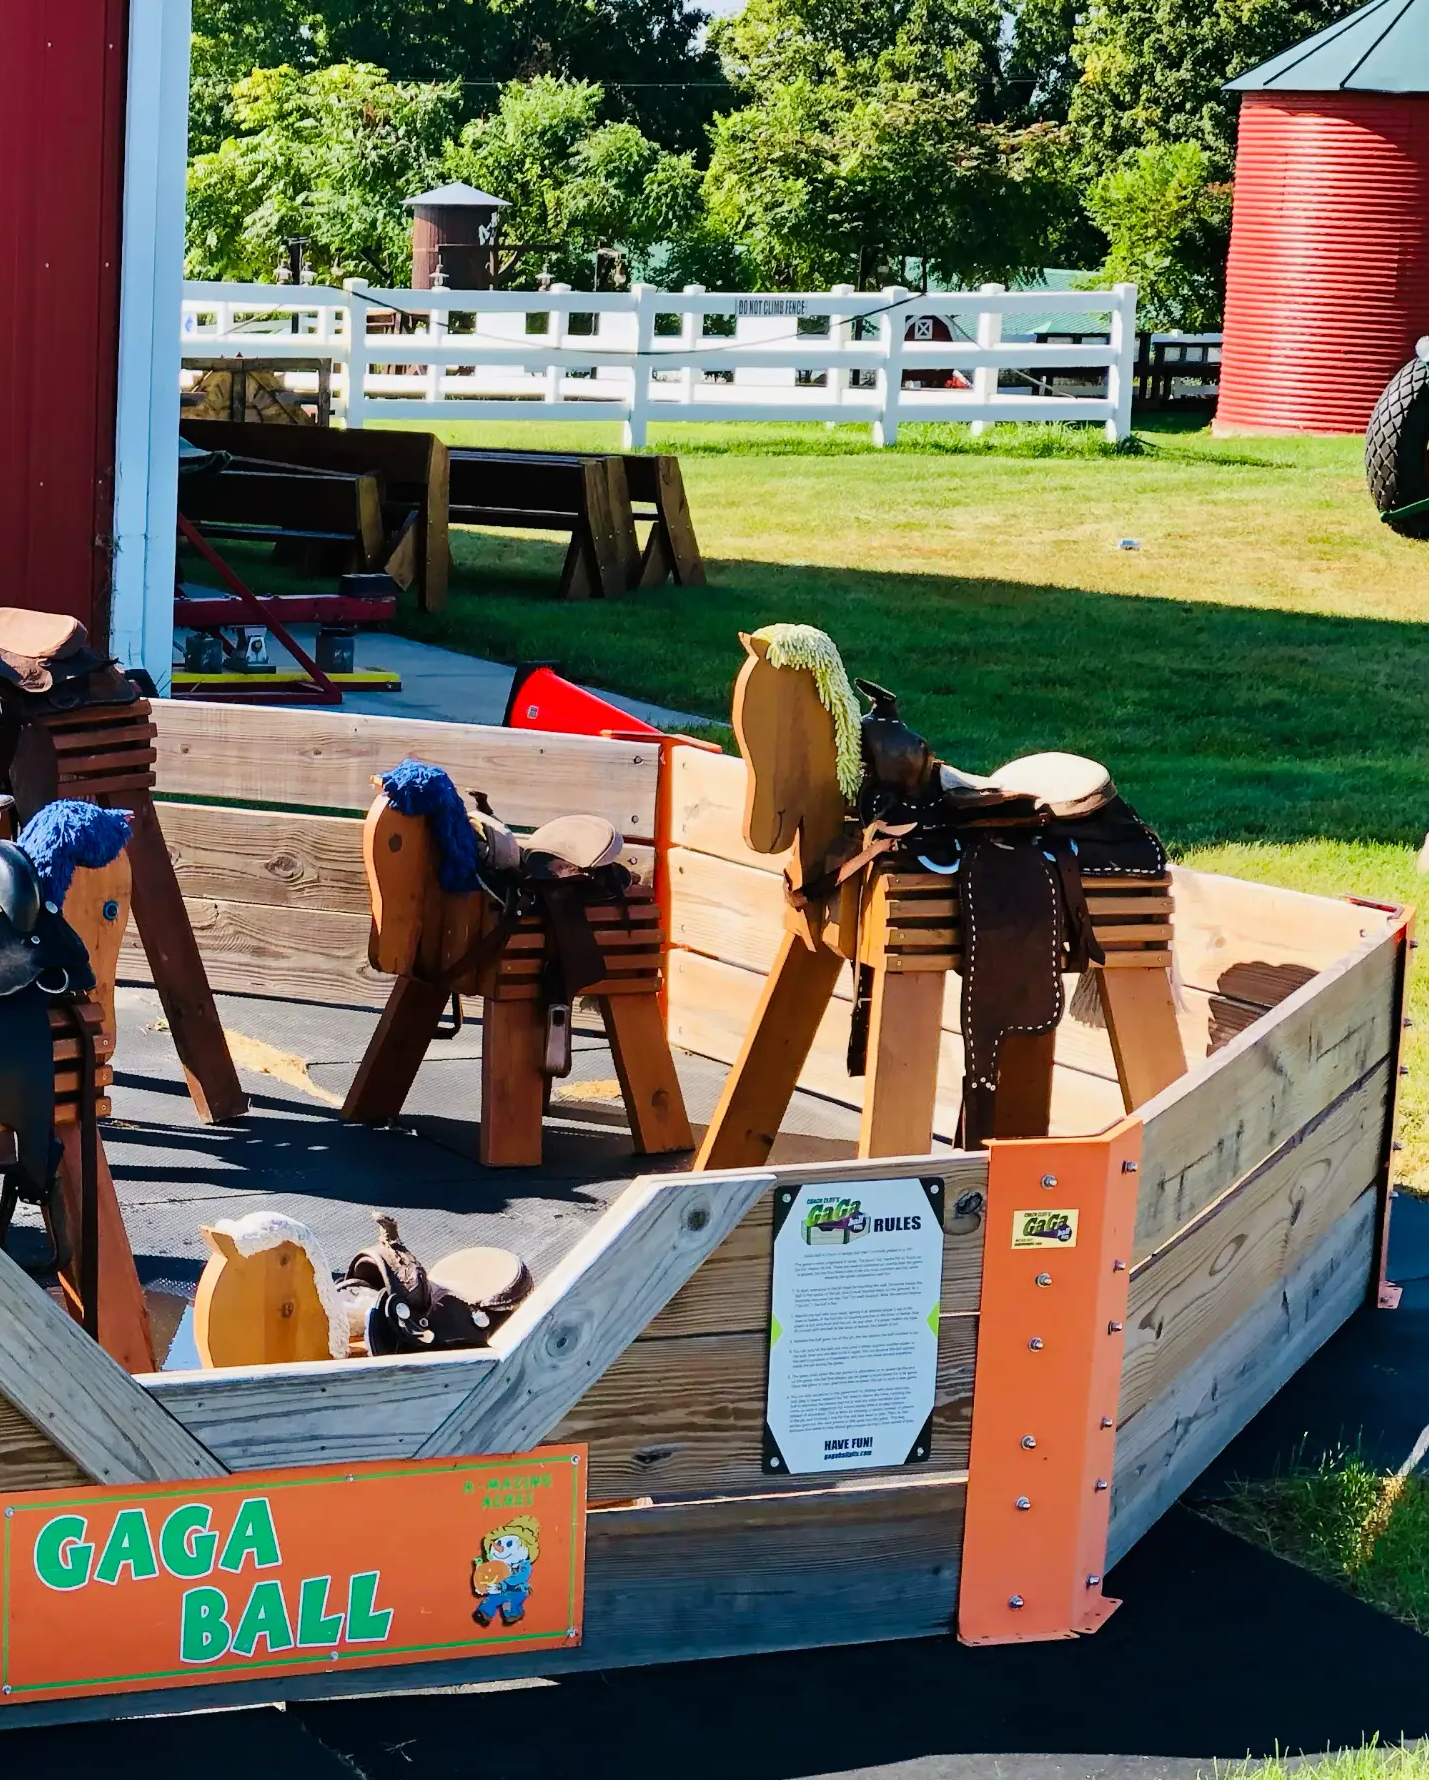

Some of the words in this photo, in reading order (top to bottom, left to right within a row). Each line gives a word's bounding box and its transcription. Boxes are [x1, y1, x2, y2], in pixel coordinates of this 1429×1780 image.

[738, 299, 748, 315] DO
[749, 299, 762, 315] NOT
[763, 299, 784, 315] CLIMB
[785, 299, 805, 315] FENCE
[873, 1216, 921, 1233] RULES
[824, 1438, 850, 1451] HAVE
[851, 1436, 873, 1449] FUN!
[481, 1491, 535, 1509] ACRES
[33, 1497, 283, 1592] GAGA
[180, 1570, 394, 1664] BALL
